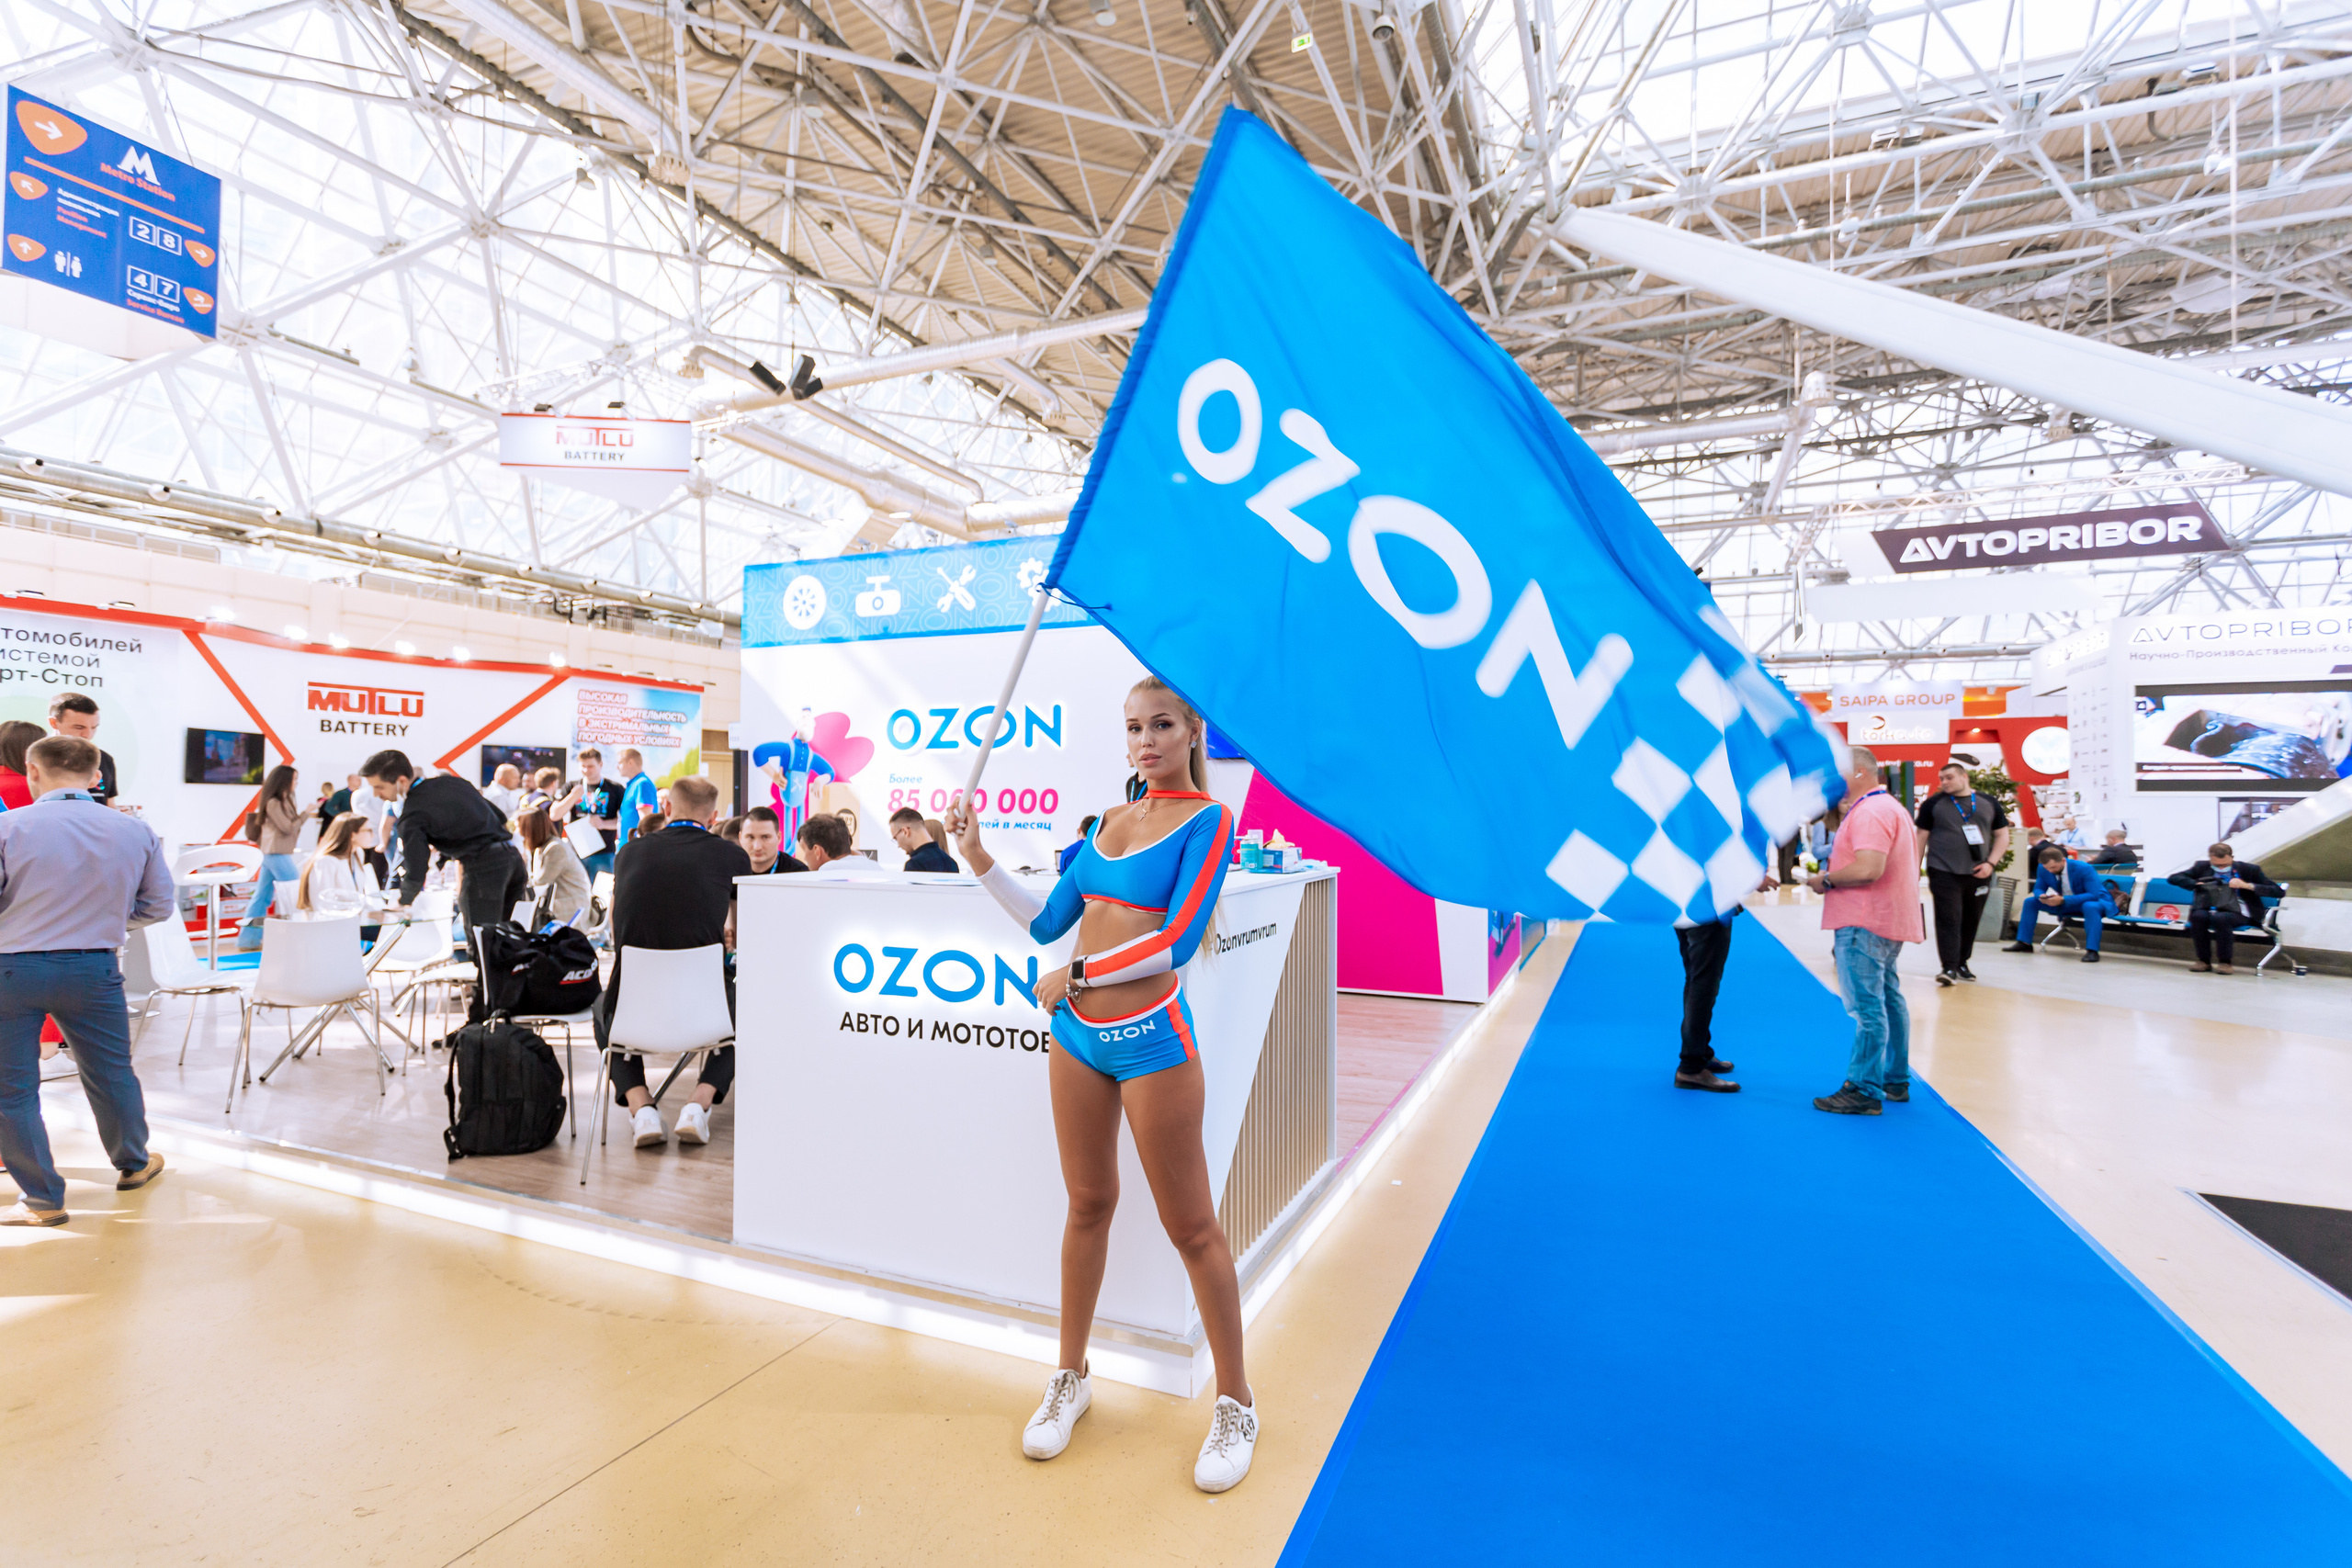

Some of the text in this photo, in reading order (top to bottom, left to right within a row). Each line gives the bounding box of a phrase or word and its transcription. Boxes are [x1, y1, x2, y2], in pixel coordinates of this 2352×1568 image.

[100, 162, 135, 185] Metro
[136, 177, 175, 202] Station
[136, 223, 175, 249] 2 8
[133, 274, 174, 296] 4 7
[556, 425, 634, 447] MUTLU
[564, 450, 626, 461] BATTERY
[1899, 514, 2203, 563] AVTOPRIBOR
[1177, 357, 1634, 750] OZON
[1, 627, 142, 653] томобилей
[308, 682, 424, 717] MUTLU
[578, 689, 628, 705] ВЫСОКАЯ
[1840, 694, 1955, 707] SAIPA GROUP
[578, 704, 687, 723] ПРОИЗВОДИТЕЛЬНОСТЬ
[320, 719, 409, 737] BATTERY
[577, 730, 682, 748] ПОГОДНЫХ УСЛОВИЯХ
[887, 704, 1061, 750] OZON
[889, 773, 922, 784] Более
[888, 788, 921, 815] 85
[998, 788, 1059, 815] 000
[1013, 820, 1052, 831] месяц
[1209, 922, 1277, 955] Ozonvrumvrum
[833, 942, 1038, 1010] OZON
[840, 1011, 900, 1036] АВТО
[908, 1018, 923, 1039] И
[1099, 1020, 1156, 1043] OZON
